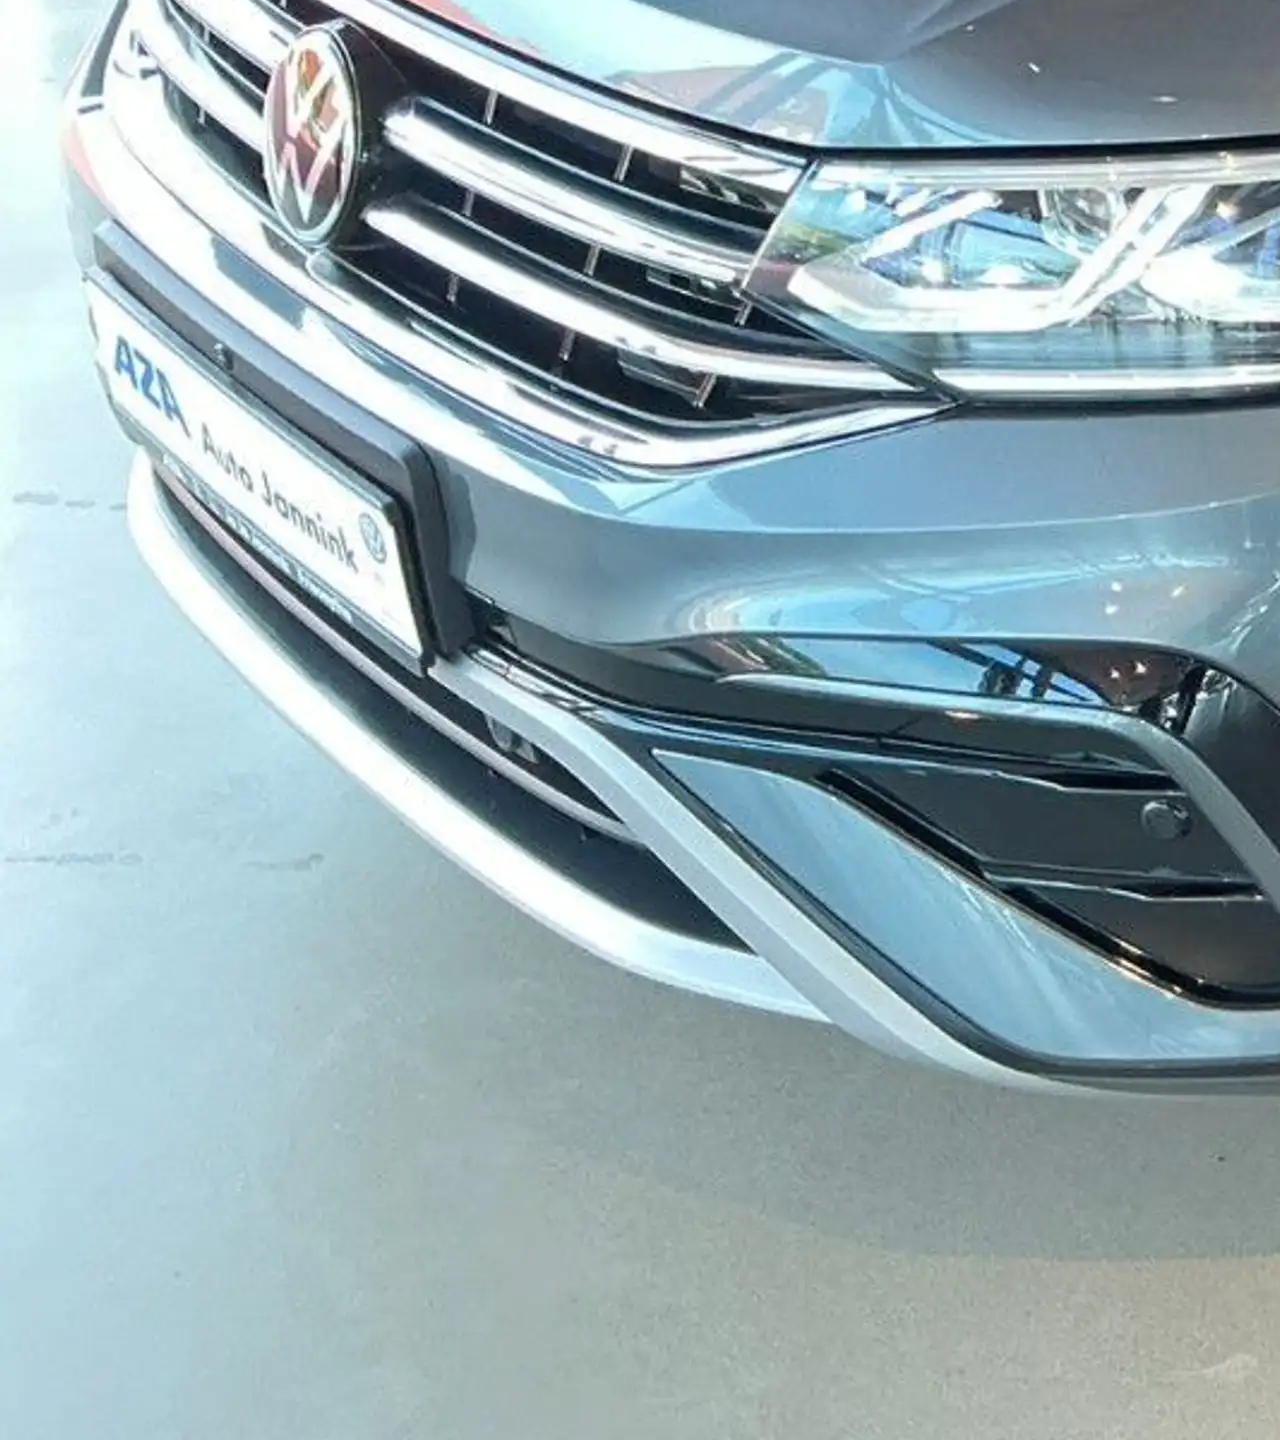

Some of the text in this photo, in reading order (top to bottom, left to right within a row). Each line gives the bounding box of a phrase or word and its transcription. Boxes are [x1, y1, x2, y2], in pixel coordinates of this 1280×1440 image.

[114, 335, 360, 575] AZA Auto Jannink
